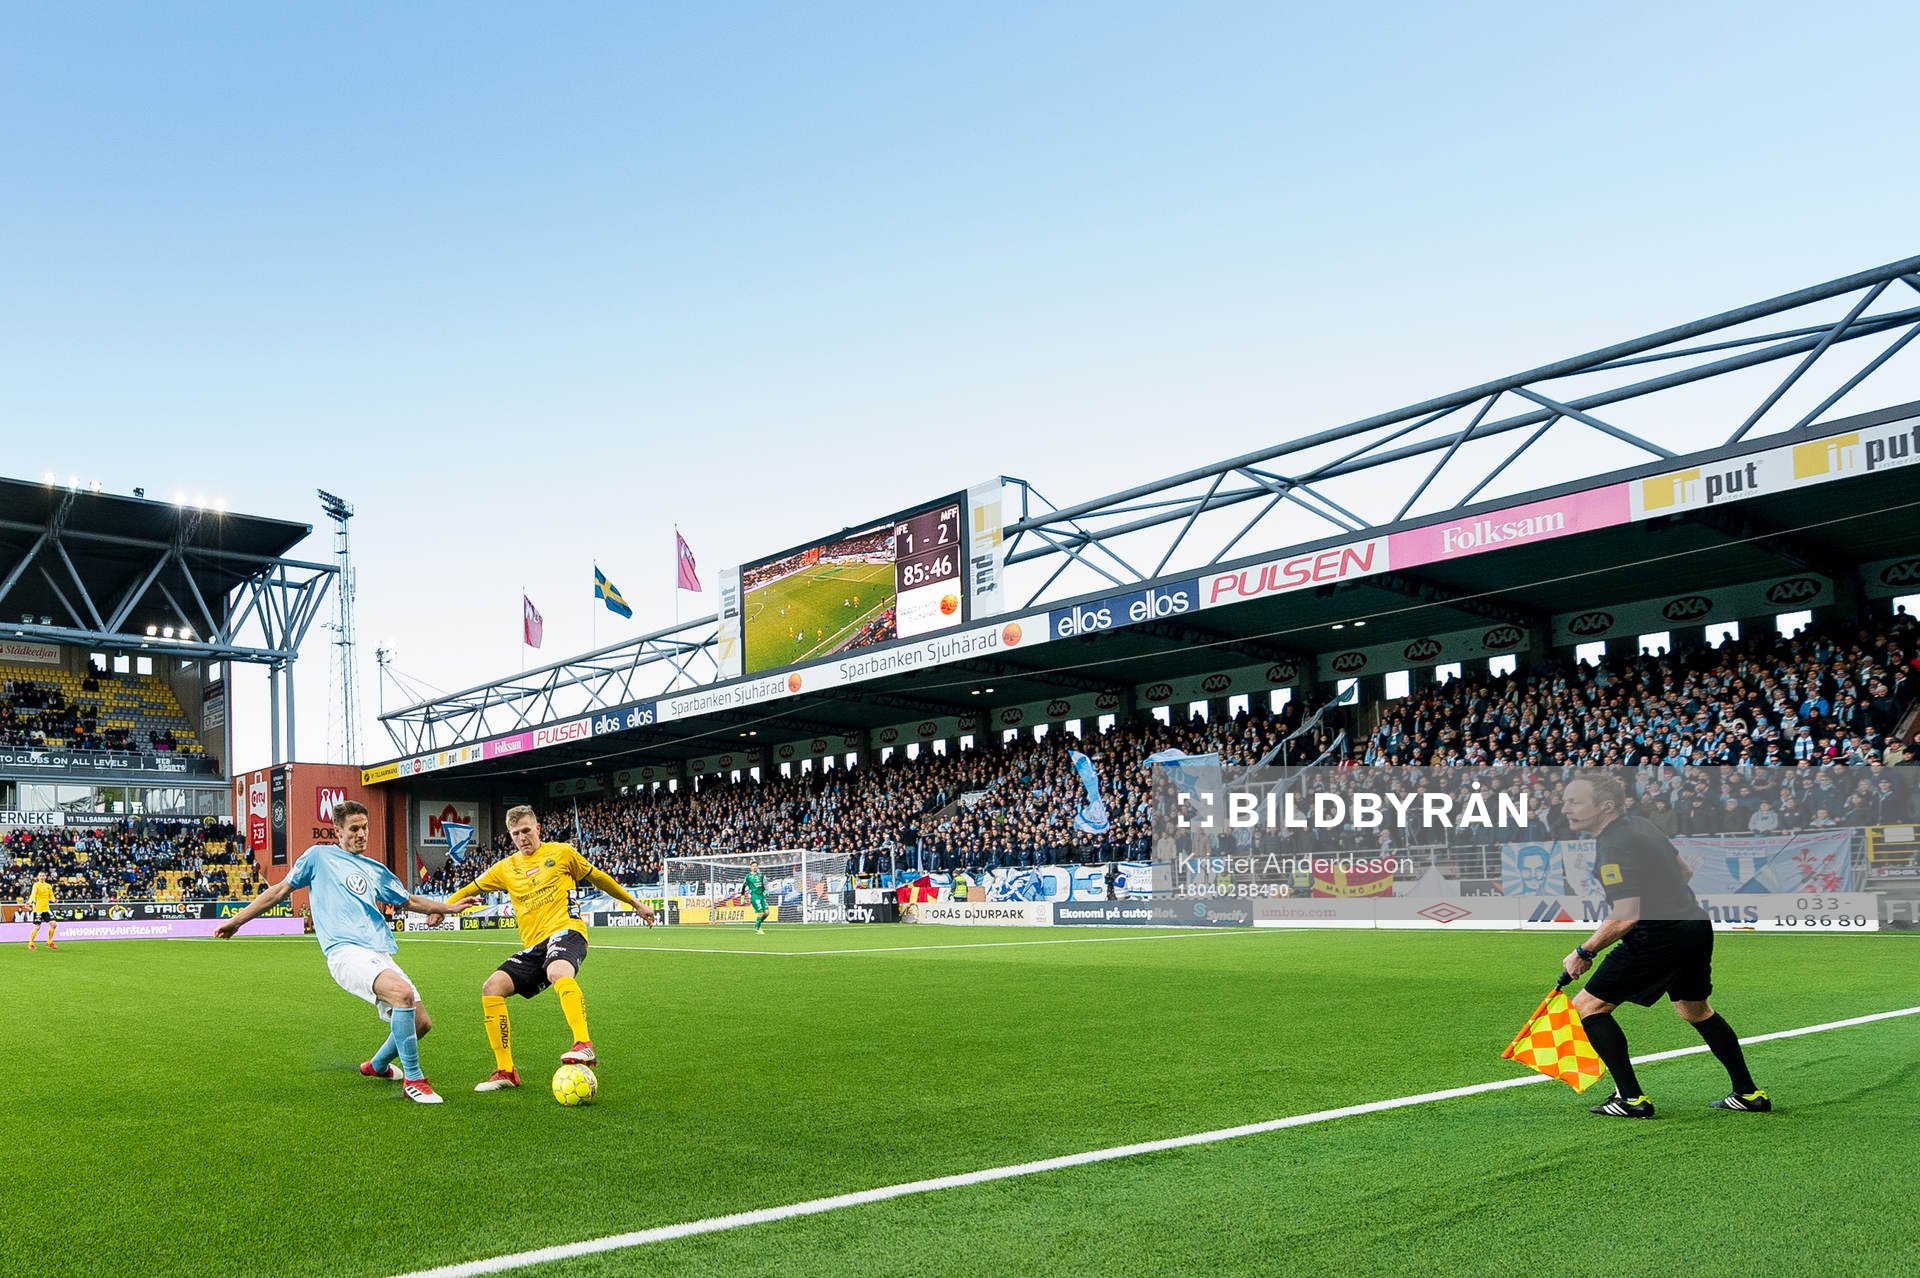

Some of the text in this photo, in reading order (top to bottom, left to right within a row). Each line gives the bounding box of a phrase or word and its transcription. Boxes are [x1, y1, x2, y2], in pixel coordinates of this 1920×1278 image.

[941, 508, 958, 522] MFF
[906, 534, 912, 553] 1
[938, 524, 948, 544] 2
[1441, 510, 1565, 554] Folksam
[904, 554, 952, 586] 85:46
[1210, 543, 1377, 603] PULSEN
[1770, 580, 1817, 600] AXA
[1129, 590, 1190, 622] ellos
[1666, 599, 1709, 618] AXA
[1058, 606, 1112, 637] ellos
[1572, 615, 1610, 632] AXA
[1485, 630, 1520, 646] AXA
[840, 629, 998, 681] Sparbanken Sjuhärad
[1407, 642, 1439, 658] AXA
[1334, 656, 1364, 668] AXA
[1267, 667, 1294, 681] AXA
[1203, 676, 1230, 690] AXA
[671, 678, 785, 716] Sparbanken Sjuhärad
[1148, 686, 1171, 698] AXA
[1002, 710, 1021, 721] AXA
[1049, 702, 1069, 714] AXA
[595, 715, 620, 734] ellos
[626, 708, 653, 727] ellos
[537, 720, 588, 746] PULSEN
[918, 723, 936, 736] AXA
[53, 757, 68, 765] ON
[72, 758, 90, 766] ALL
[1326, 882, 1384, 894] MALMÖ FF
[964, 910, 1024, 919] DJURPARK
[1060, 908, 1178, 920] Ekonomi på autopilot.
[1206, 910, 1247, 923] Syncify
[1262, 906, 1336, 917] umbro.com
[464, 919, 478, 928] EAB
[500, 918, 515, 928] EAB
